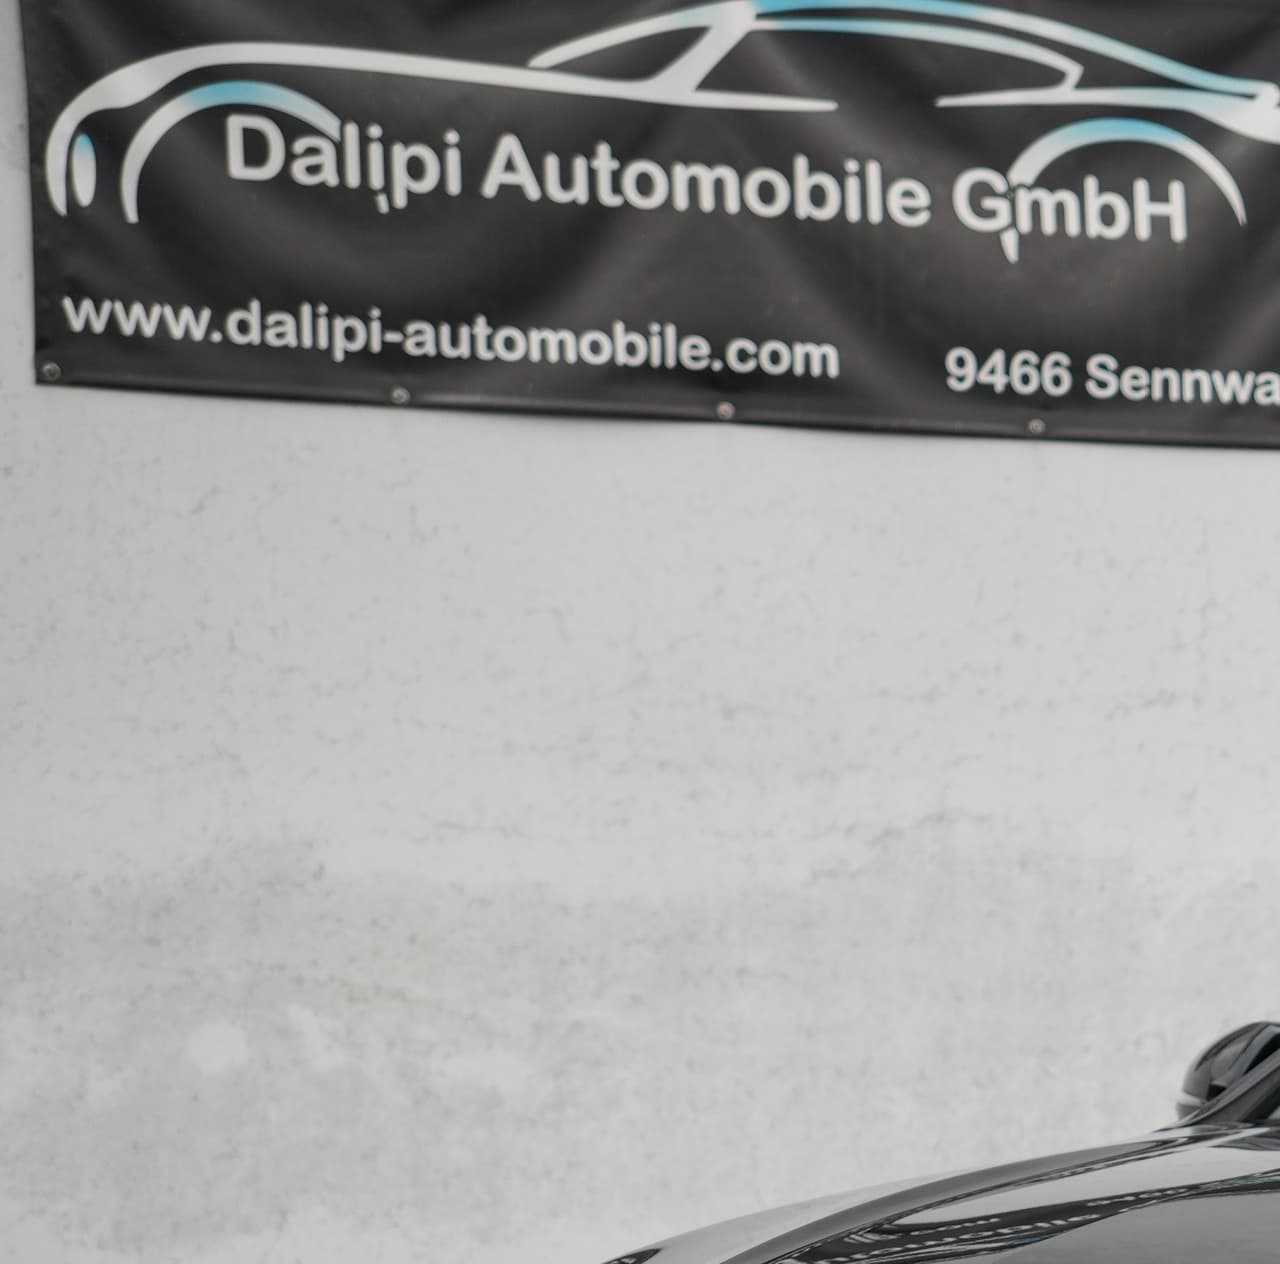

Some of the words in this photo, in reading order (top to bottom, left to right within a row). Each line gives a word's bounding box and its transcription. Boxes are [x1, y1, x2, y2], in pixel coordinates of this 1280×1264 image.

[225, 113, 463, 208] Dalipi
[481, 135, 932, 227] Automobile
[952, 168, 1188, 242] GmbH
[62, 295, 841, 380] www.dalipi-automobile.com
[944, 345, 1073, 397] 9466
